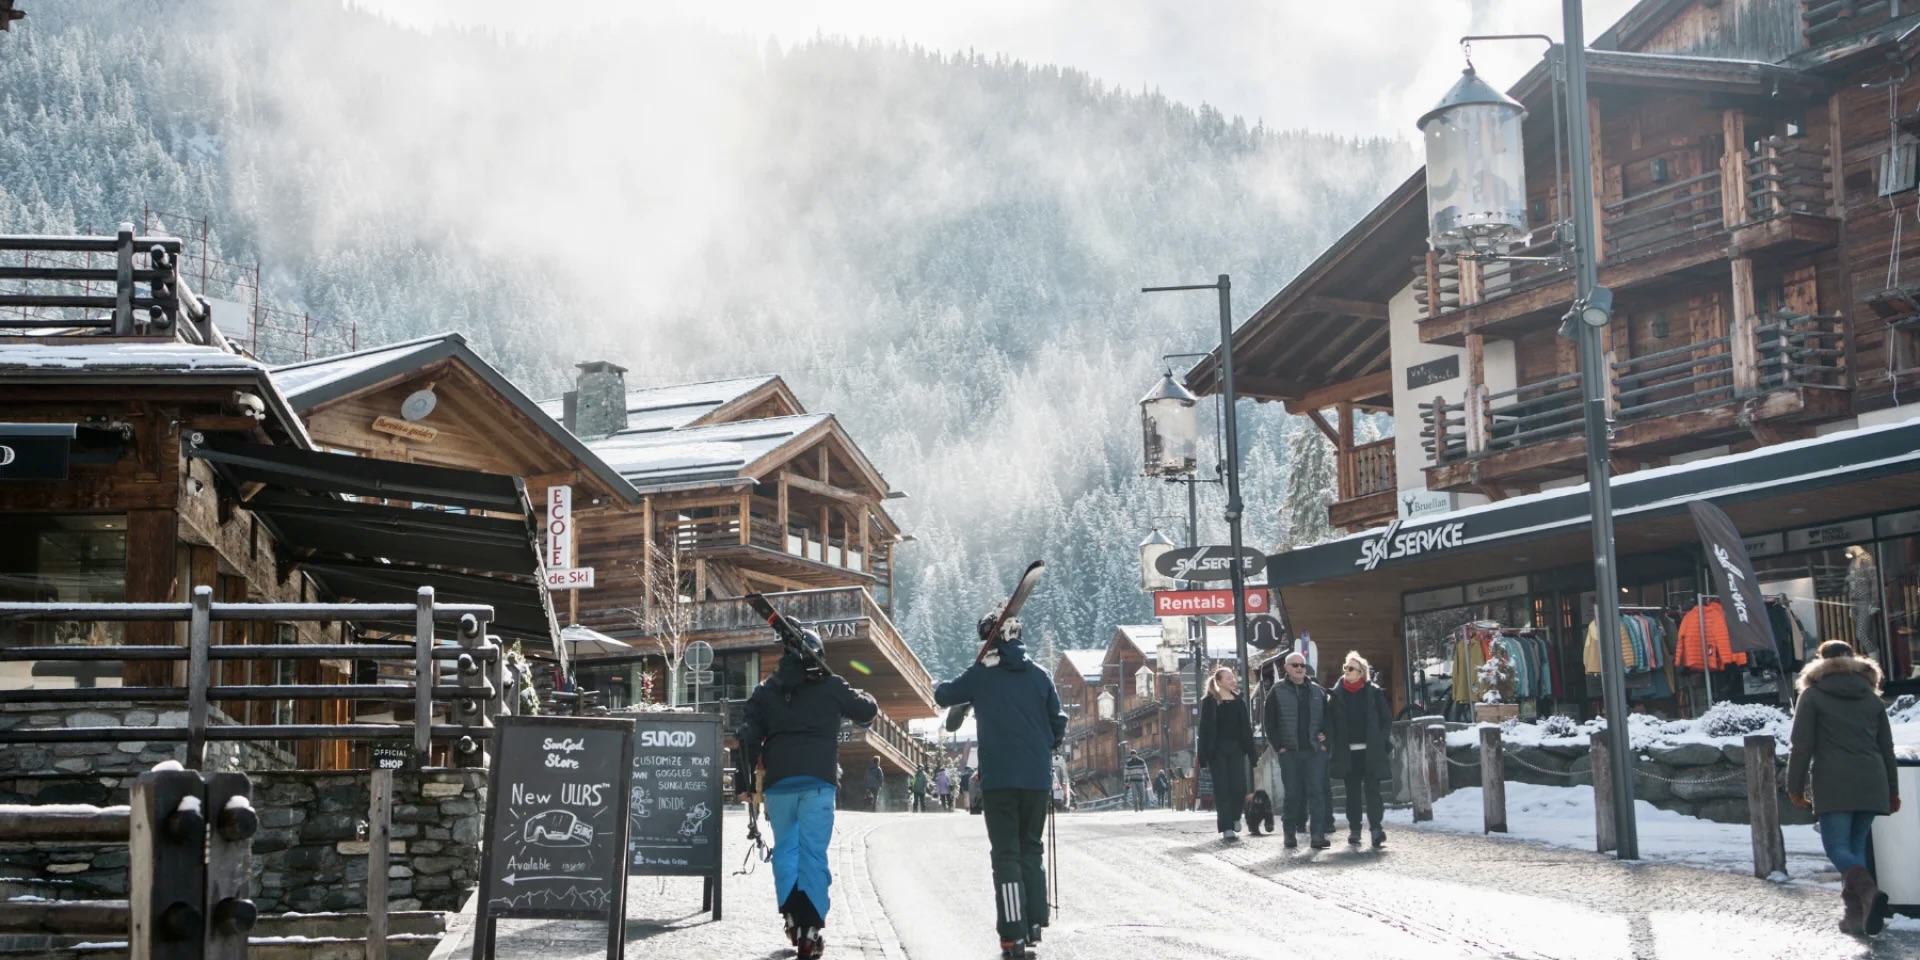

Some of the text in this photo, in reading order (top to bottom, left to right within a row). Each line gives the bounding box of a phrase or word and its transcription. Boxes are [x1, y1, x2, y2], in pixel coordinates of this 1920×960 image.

[550, 489, 565, 566] ECOLE
[1355, 522, 1467, 570] SKI SERVICE
[548, 571, 589, 584] de Ski
[1160, 595, 1225, 610] Rentals
[825, 622, 856, 638] VIN
[543, 737, 584, 753] SunGod
[641, 731, 696, 747] SUNGOD
[373, 749, 407, 757] OFFICIAL
[380, 759, 404, 769] SHOP
[545, 754, 579, 769] Store
[691, 756, 711, 766] YOUR
[655, 769, 692, 778] GOGGLES
[657, 781, 708, 791] SUNGLASSES
[512, 783, 551, 805] New
[658, 796, 685, 810] INSIDE
[507, 856, 551, 871] Available
